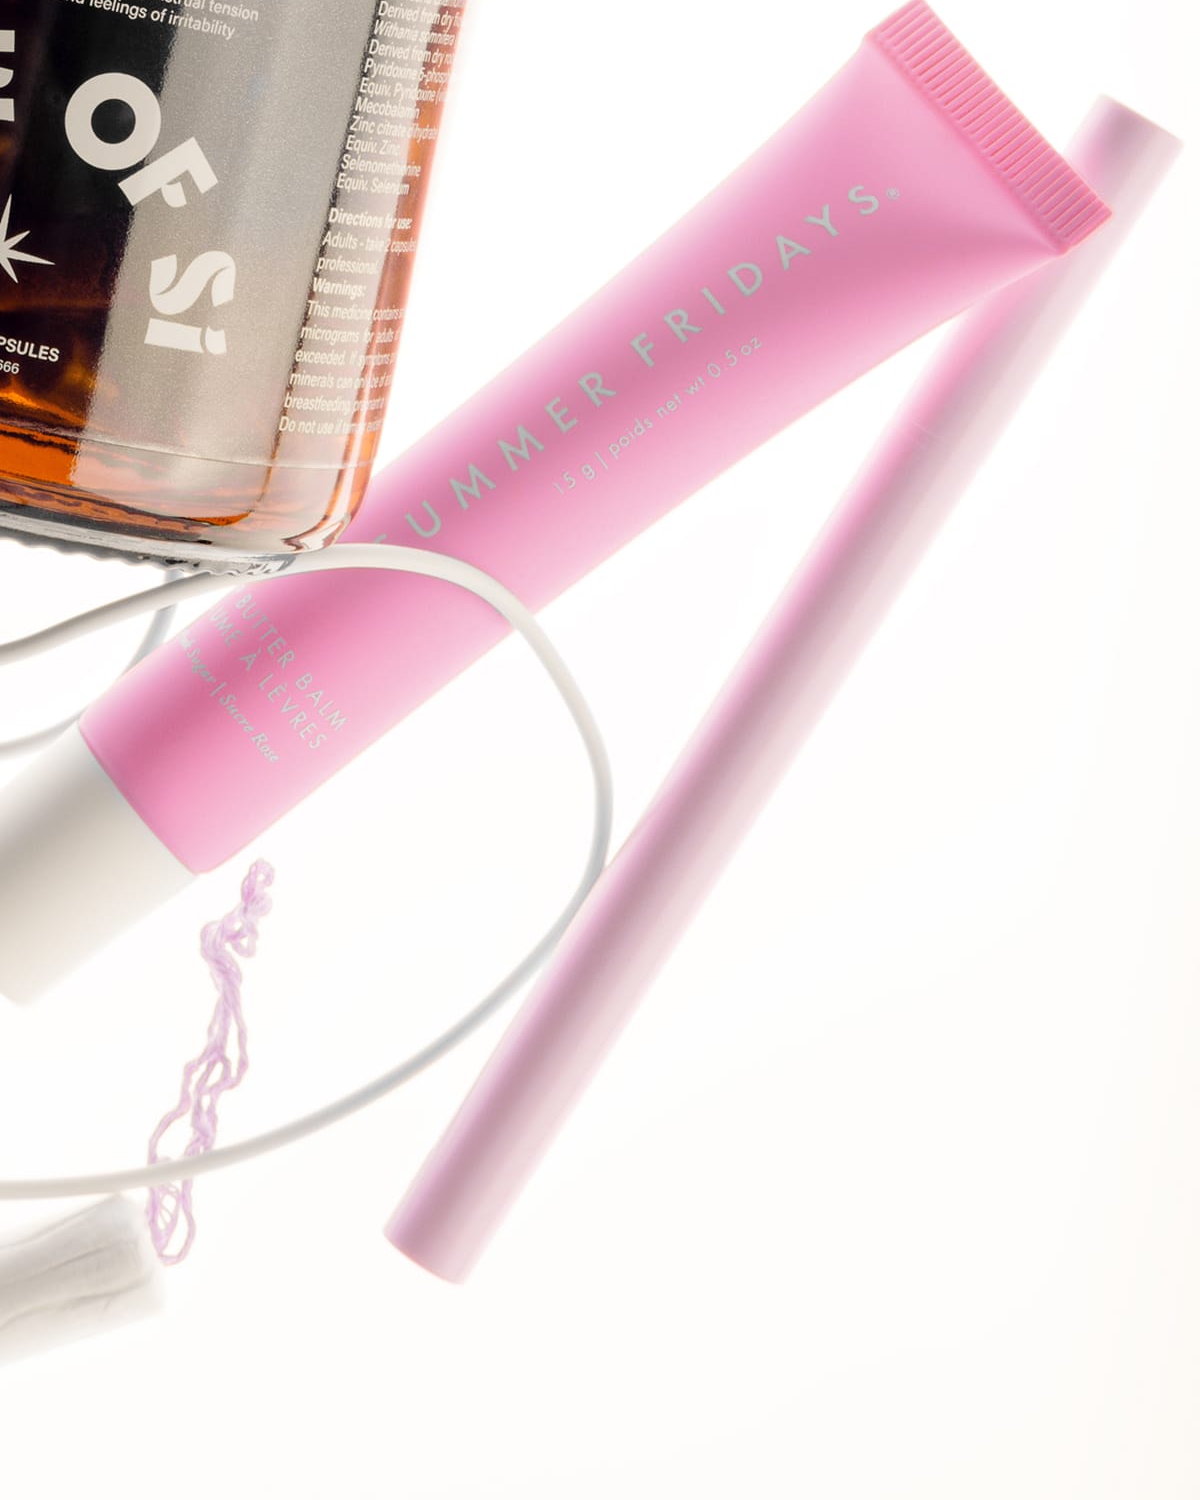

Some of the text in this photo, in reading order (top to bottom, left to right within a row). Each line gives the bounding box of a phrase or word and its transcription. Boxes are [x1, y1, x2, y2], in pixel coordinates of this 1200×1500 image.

[209, 0, 259, 21] tension
[378, 0, 421, 21] Derived
[421, 8, 440, 24] from
[441, 11, 454, 30] dry
[150, 9, 167, 23] of
[168, 11, 236, 41] irritability
[373, 19, 418, 41] Withania
[369, 38, 410, 60] Derived
[411, 48, 431, 63] from
[432, 49, 445, 67] dry
[364, 57, 418, 80] Pyridoxine
[360, 77, 391, 98] Equiv.
[350, 115, 375, 133] Zinc
[377, 119, 407, 137] citrate
[64, 71, 219, 209] OF
[346, 135, 377, 154] Equiv.
[337, 173, 369, 193] Equiv.
[329, 207, 383, 228] Directions
[322, 231, 358, 250] Adults
[313, 277, 367, 300] Warnings:
[307, 300, 330, 317] This
[300, 324, 360, 346] micrograms
[295, 349, 346, 365] exceeded.
[289, 370, 334, 387] minerals
[278, 416, 295, 432] Do
[297, 421, 315, 434] not
[317, 424, 334, 435] use
[552, 471, 576, 495] 15
[581, 463, 597, 480] g
[608, 418, 653, 460] poids
[656, 393, 684, 419] net
[685, 376, 706, 396] wt
[740, 337, 763, 356] oz
[373, 371, 616, 544] UMMER
[235, 593, 348, 732] BUTTER BALM
